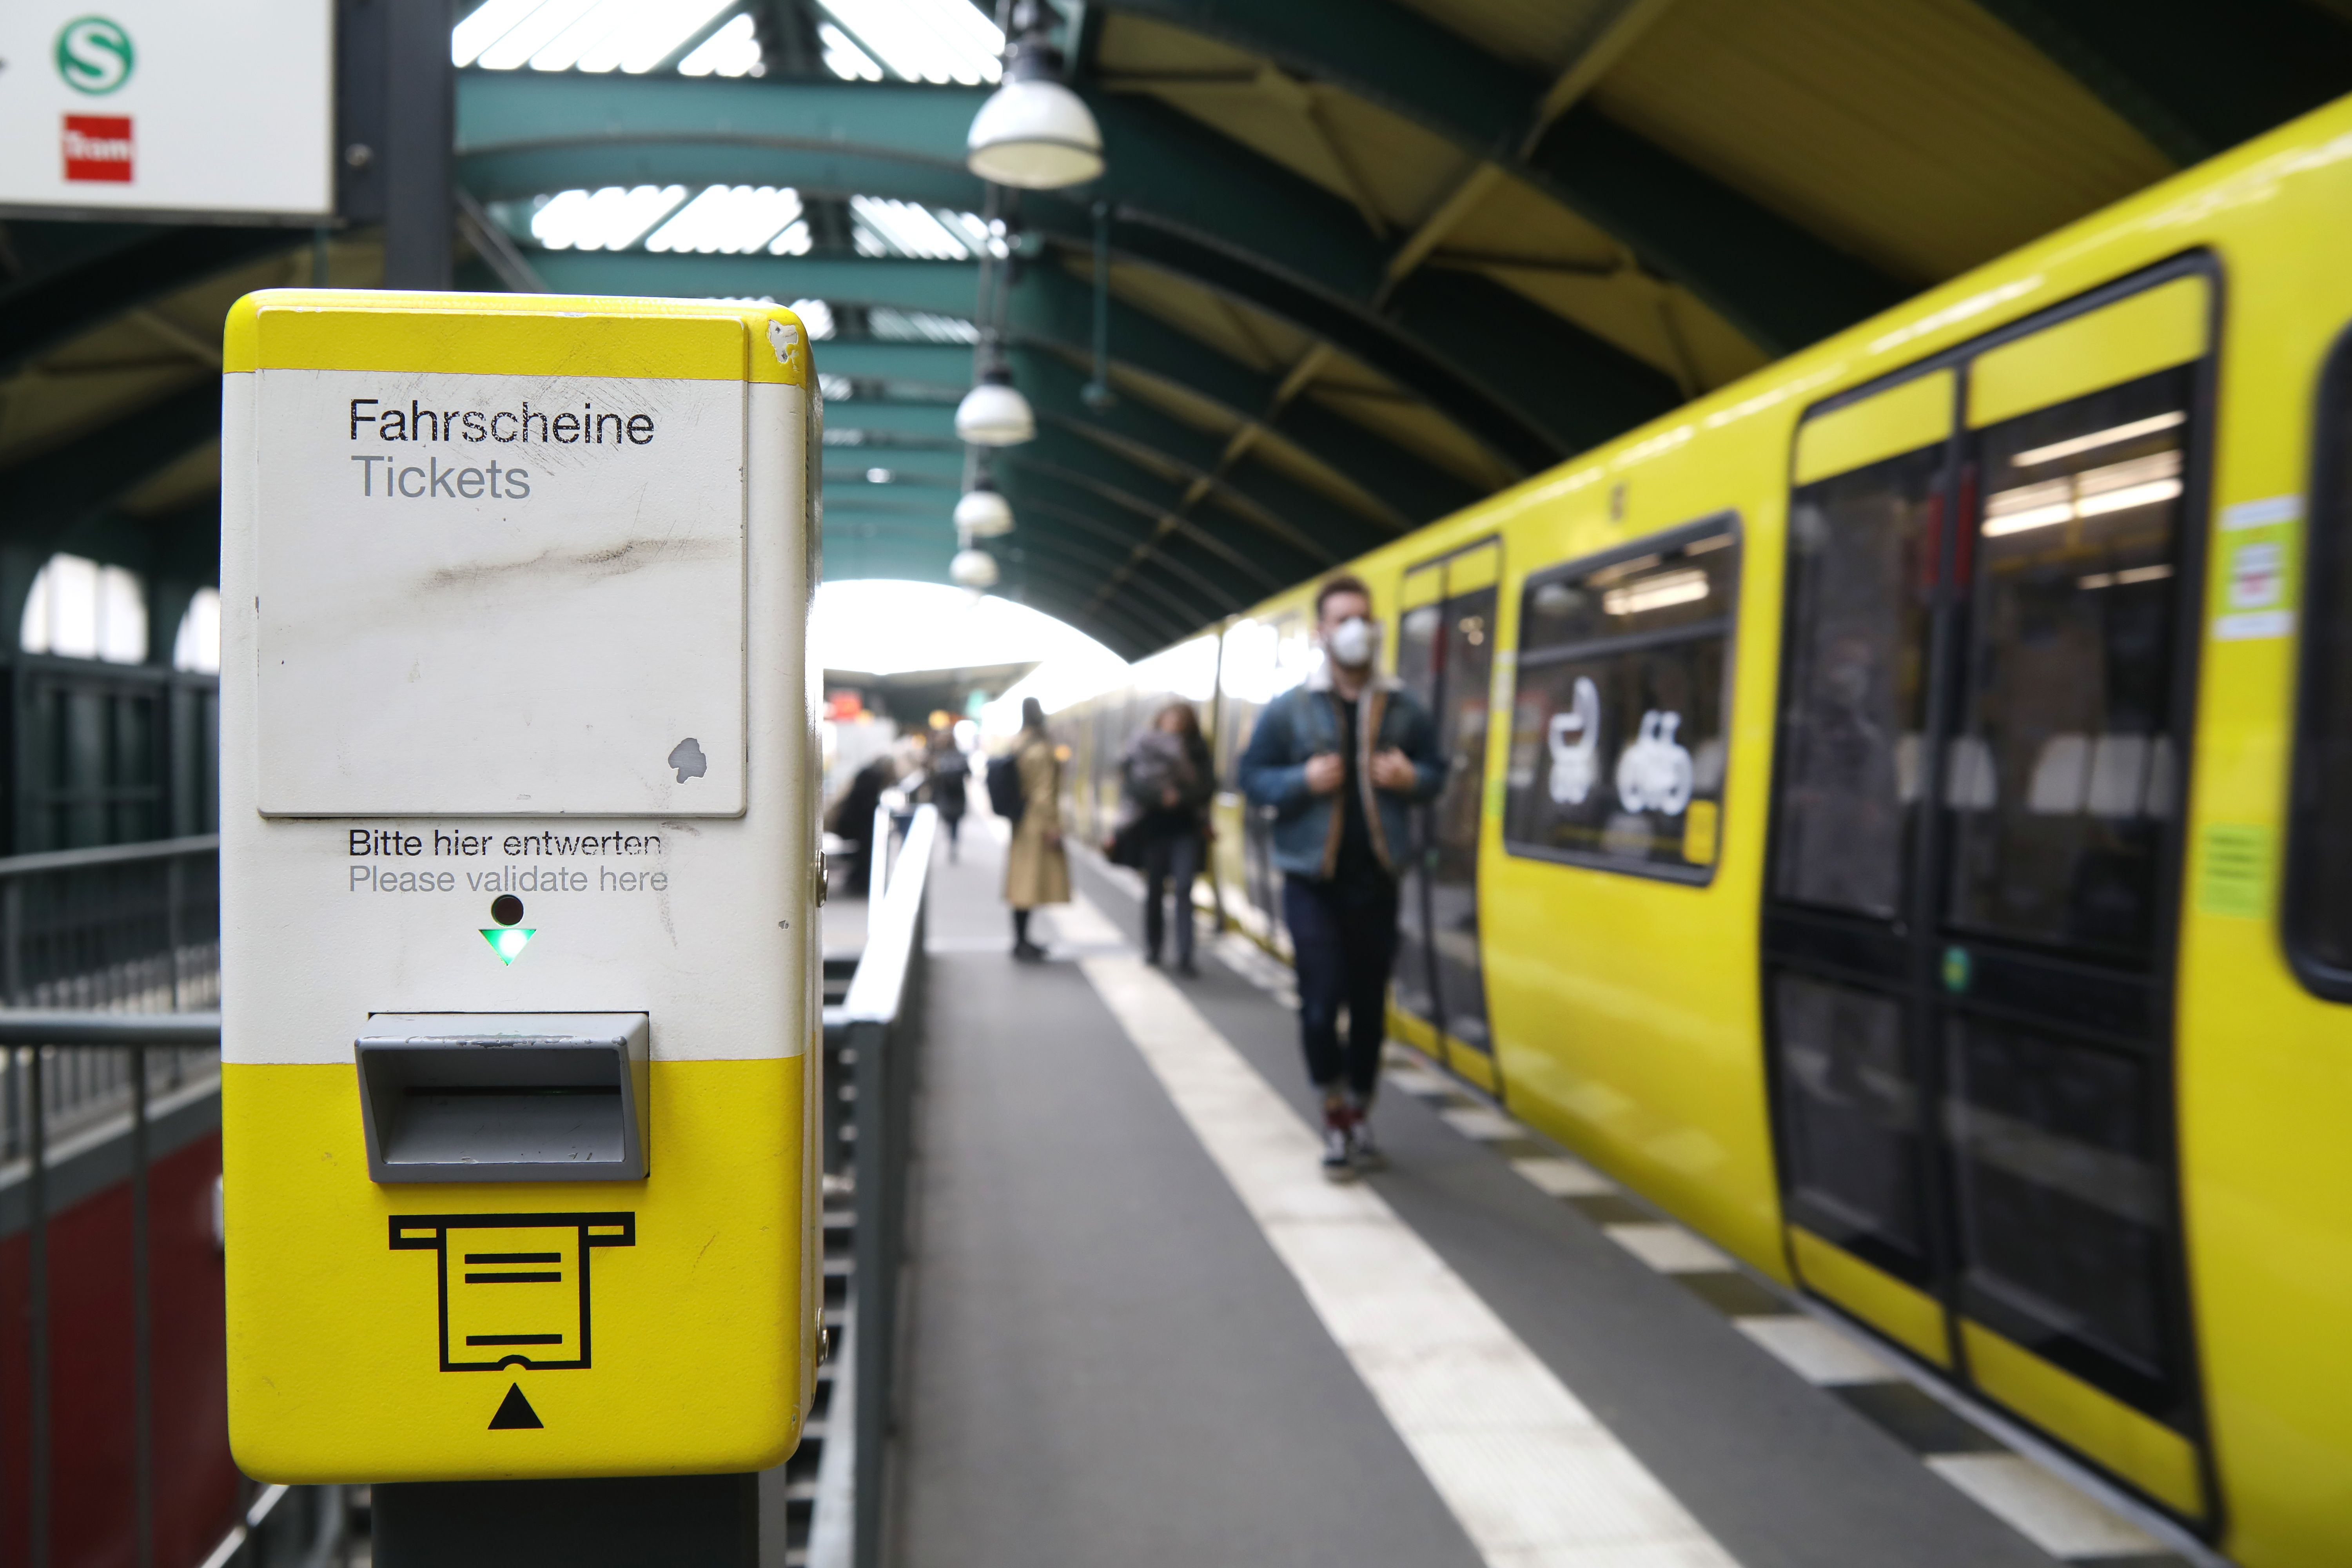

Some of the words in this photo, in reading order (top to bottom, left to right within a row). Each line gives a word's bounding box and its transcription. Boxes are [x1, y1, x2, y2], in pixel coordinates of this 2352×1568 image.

[63, 20, 127, 90] S
[64, 130, 130, 161] Tram
[350, 399, 654, 445] Fahrscheine
[351, 456, 531, 499] Tickets
[349, 829, 422, 856] Bitte
[434, 830, 492, 856] hier
[503, 830, 661, 856] entwerten
[350, 865, 455, 892] Please
[466, 865, 588, 892] validate
[599, 866, 668, 892] here
